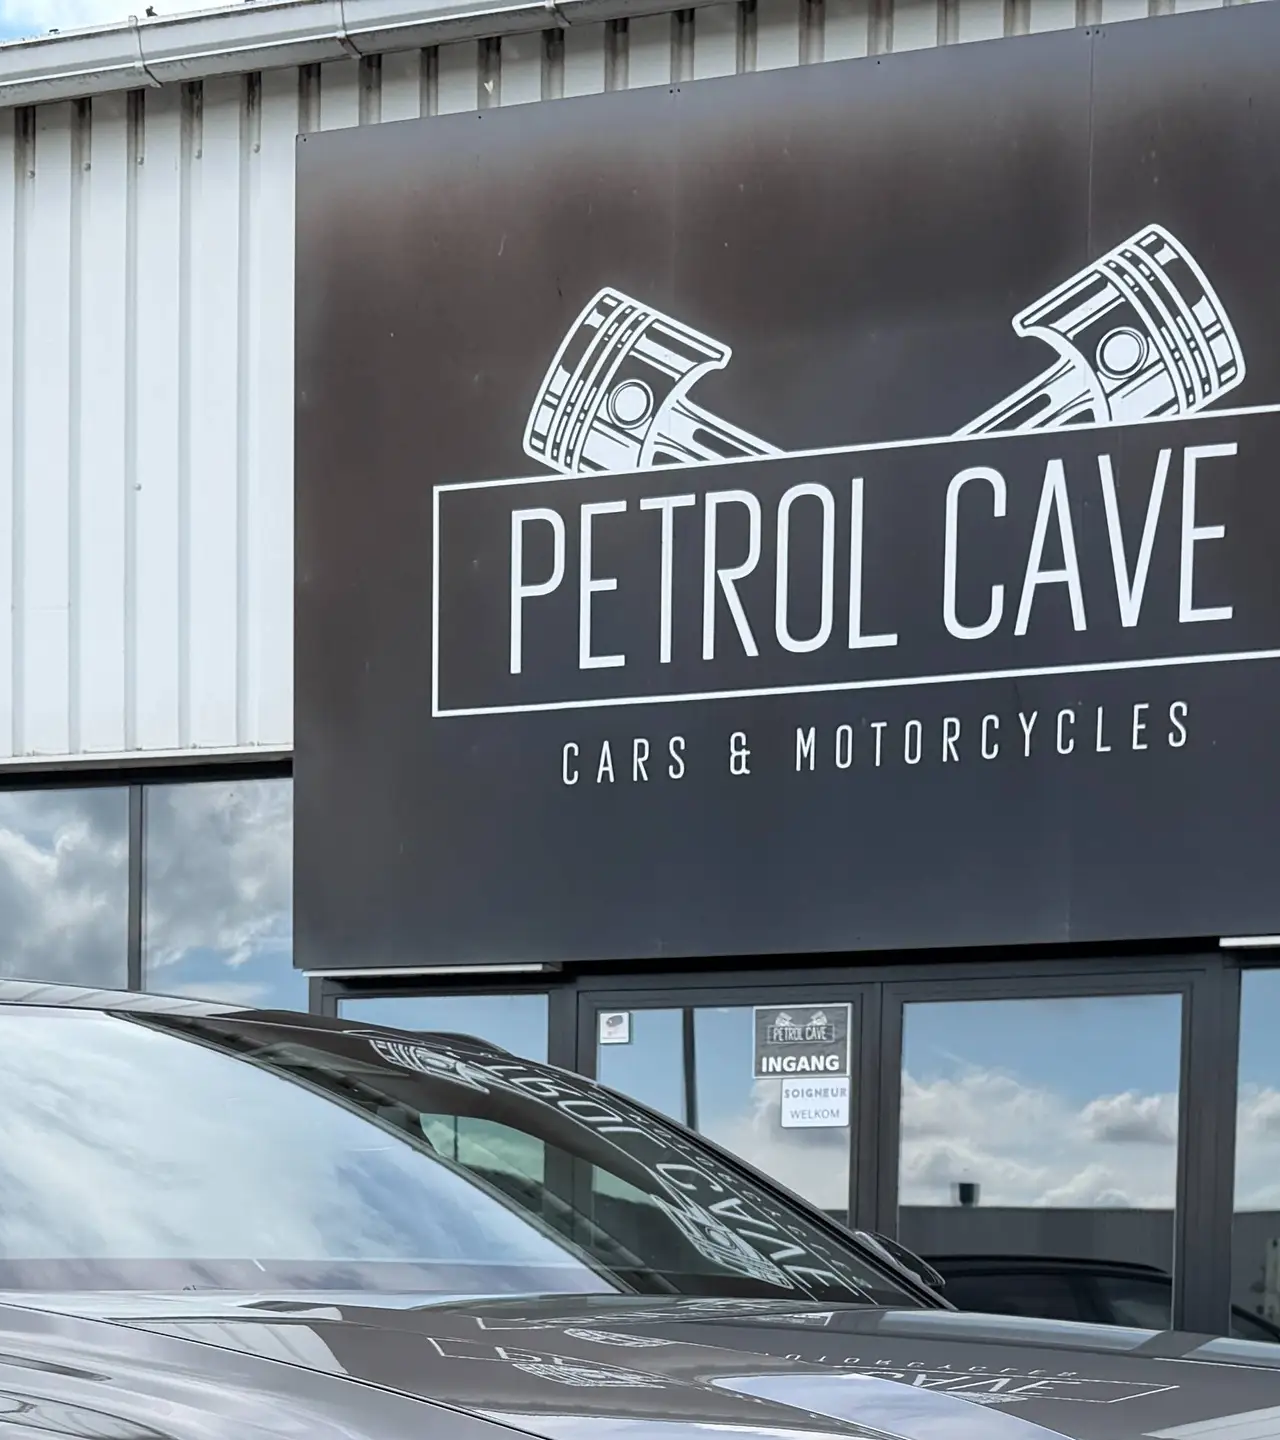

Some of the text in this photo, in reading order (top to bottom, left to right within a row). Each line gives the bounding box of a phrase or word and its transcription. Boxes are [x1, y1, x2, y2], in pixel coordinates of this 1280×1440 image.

[509, 441, 1239, 674] PETROL CAVE
[562, 700, 1189, 785] CARS & MOTORCYCLES
[761, 1054, 840, 1073] INGANG
[783, 1087, 848, 1099] SOIGNEUR
[789, 1109, 840, 1120] WELKOM
